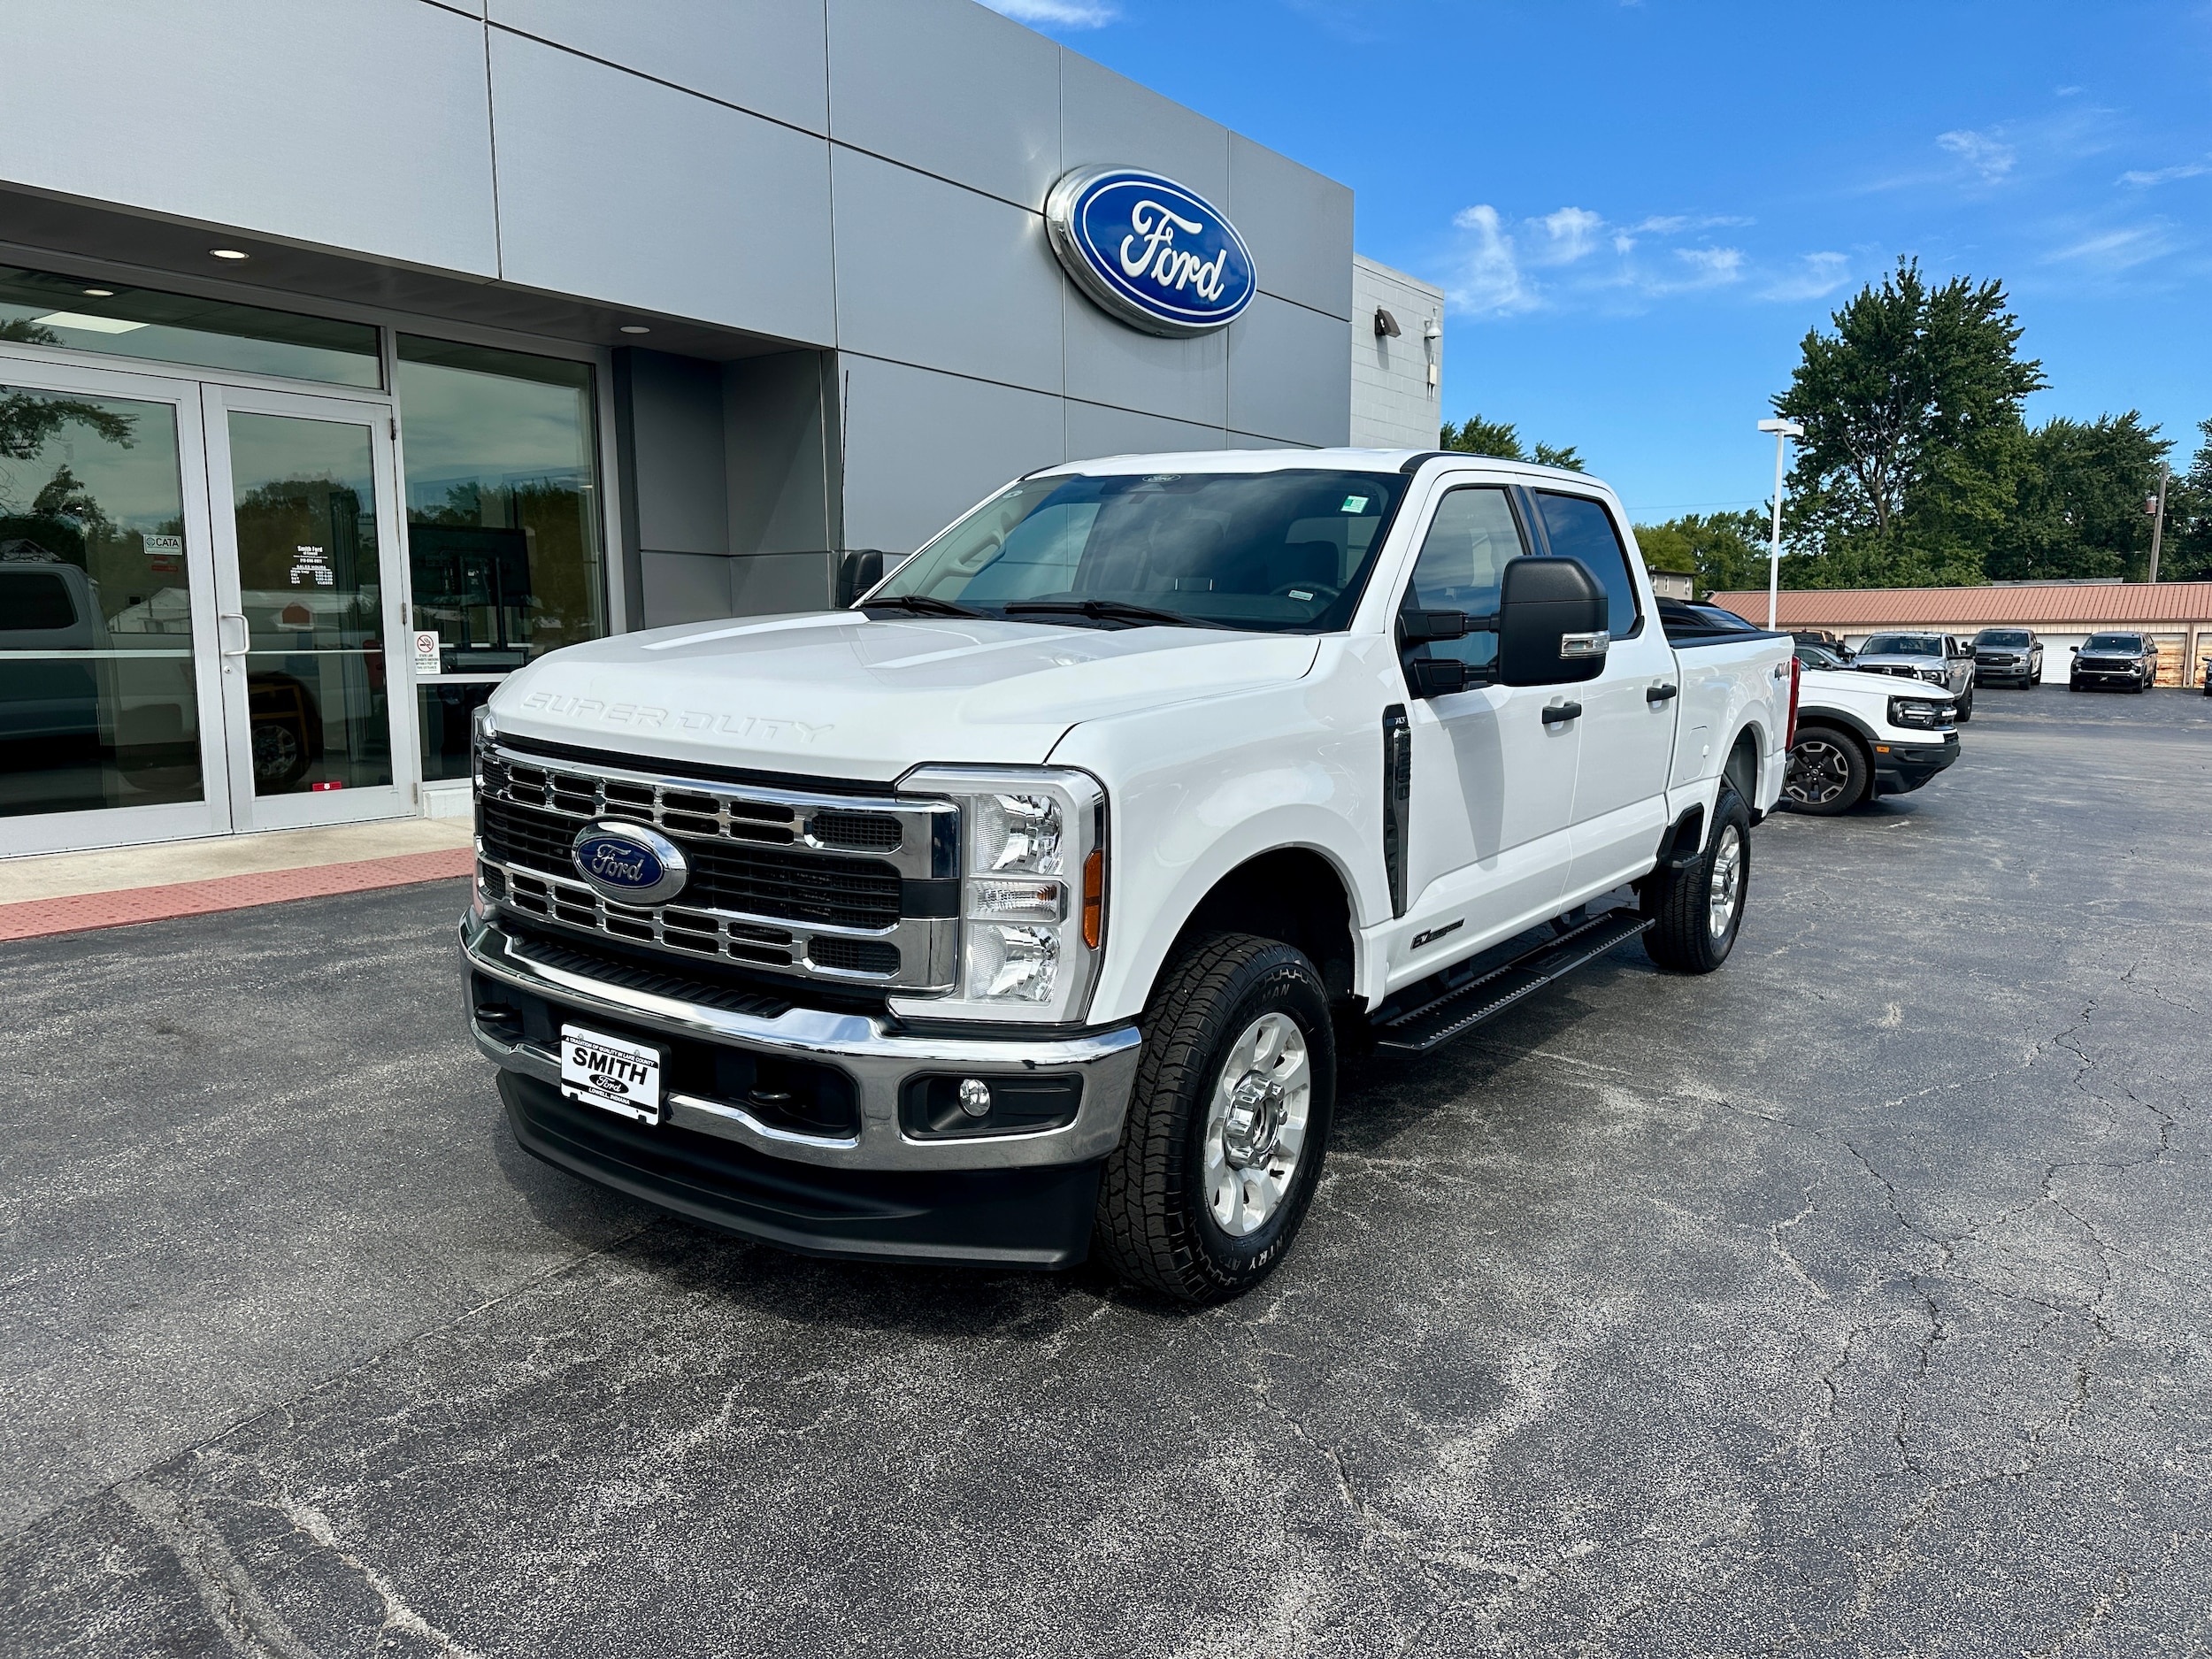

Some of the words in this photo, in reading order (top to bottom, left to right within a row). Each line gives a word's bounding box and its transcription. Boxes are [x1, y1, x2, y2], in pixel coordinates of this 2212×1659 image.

[1120, 200, 1227, 302] Ford
[156, 537, 180, 547] CATA
[520, 692, 669, 728] SUPER
[672, 710, 835, 743] DUTY
[591, 843, 644, 881] Ford
[570, 1037, 592, 1049] TRADITION
[572, 1047, 649, 1086] SMITH
[595, 1074, 622, 1093] Ford
[610, 1094, 631, 1105] INDIANA
